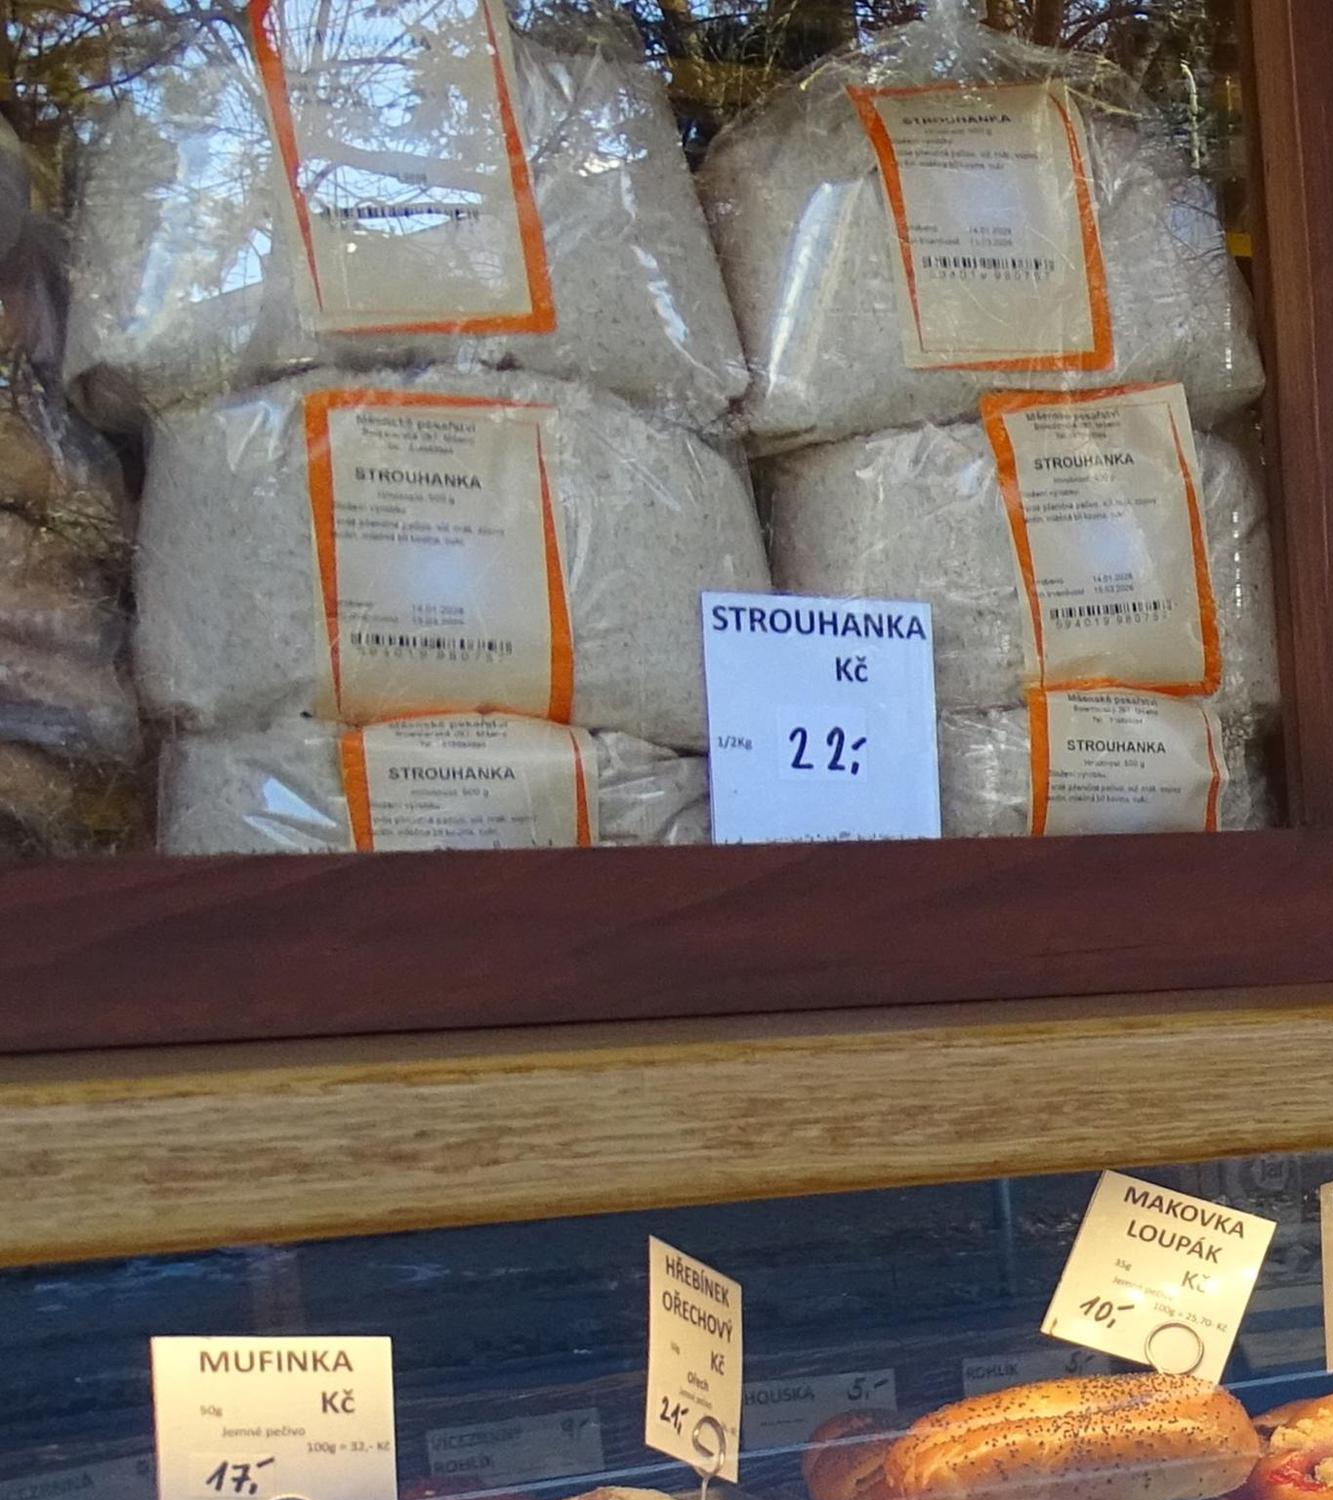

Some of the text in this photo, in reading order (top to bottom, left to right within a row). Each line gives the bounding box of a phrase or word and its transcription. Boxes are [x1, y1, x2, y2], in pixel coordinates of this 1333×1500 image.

[1034, 453, 1135, 471] STROUHANKA
[355, 466, 482, 490] STROUHANKA
[711, 605, 927, 640] STROUHANKA
[835, 656, 869, 682] Kč
[1067, 739, 1167, 753] STROUHANKA
[388, 766, 516, 781] STROUHANKA
[1123, 1186, 1245, 1239] MAKOVKA
[1126, 1219, 1223, 1264] LOUPÁK
[665, 1254, 730, 1308] HŘEBÍNEK
[662, 1289, 733, 1343] OŘECHOVÝ
[199, 1349, 354, 1374] MUFINKA
[710, 1349, 725, 1376] Kč
[321, 1389, 355, 1414] Kč
